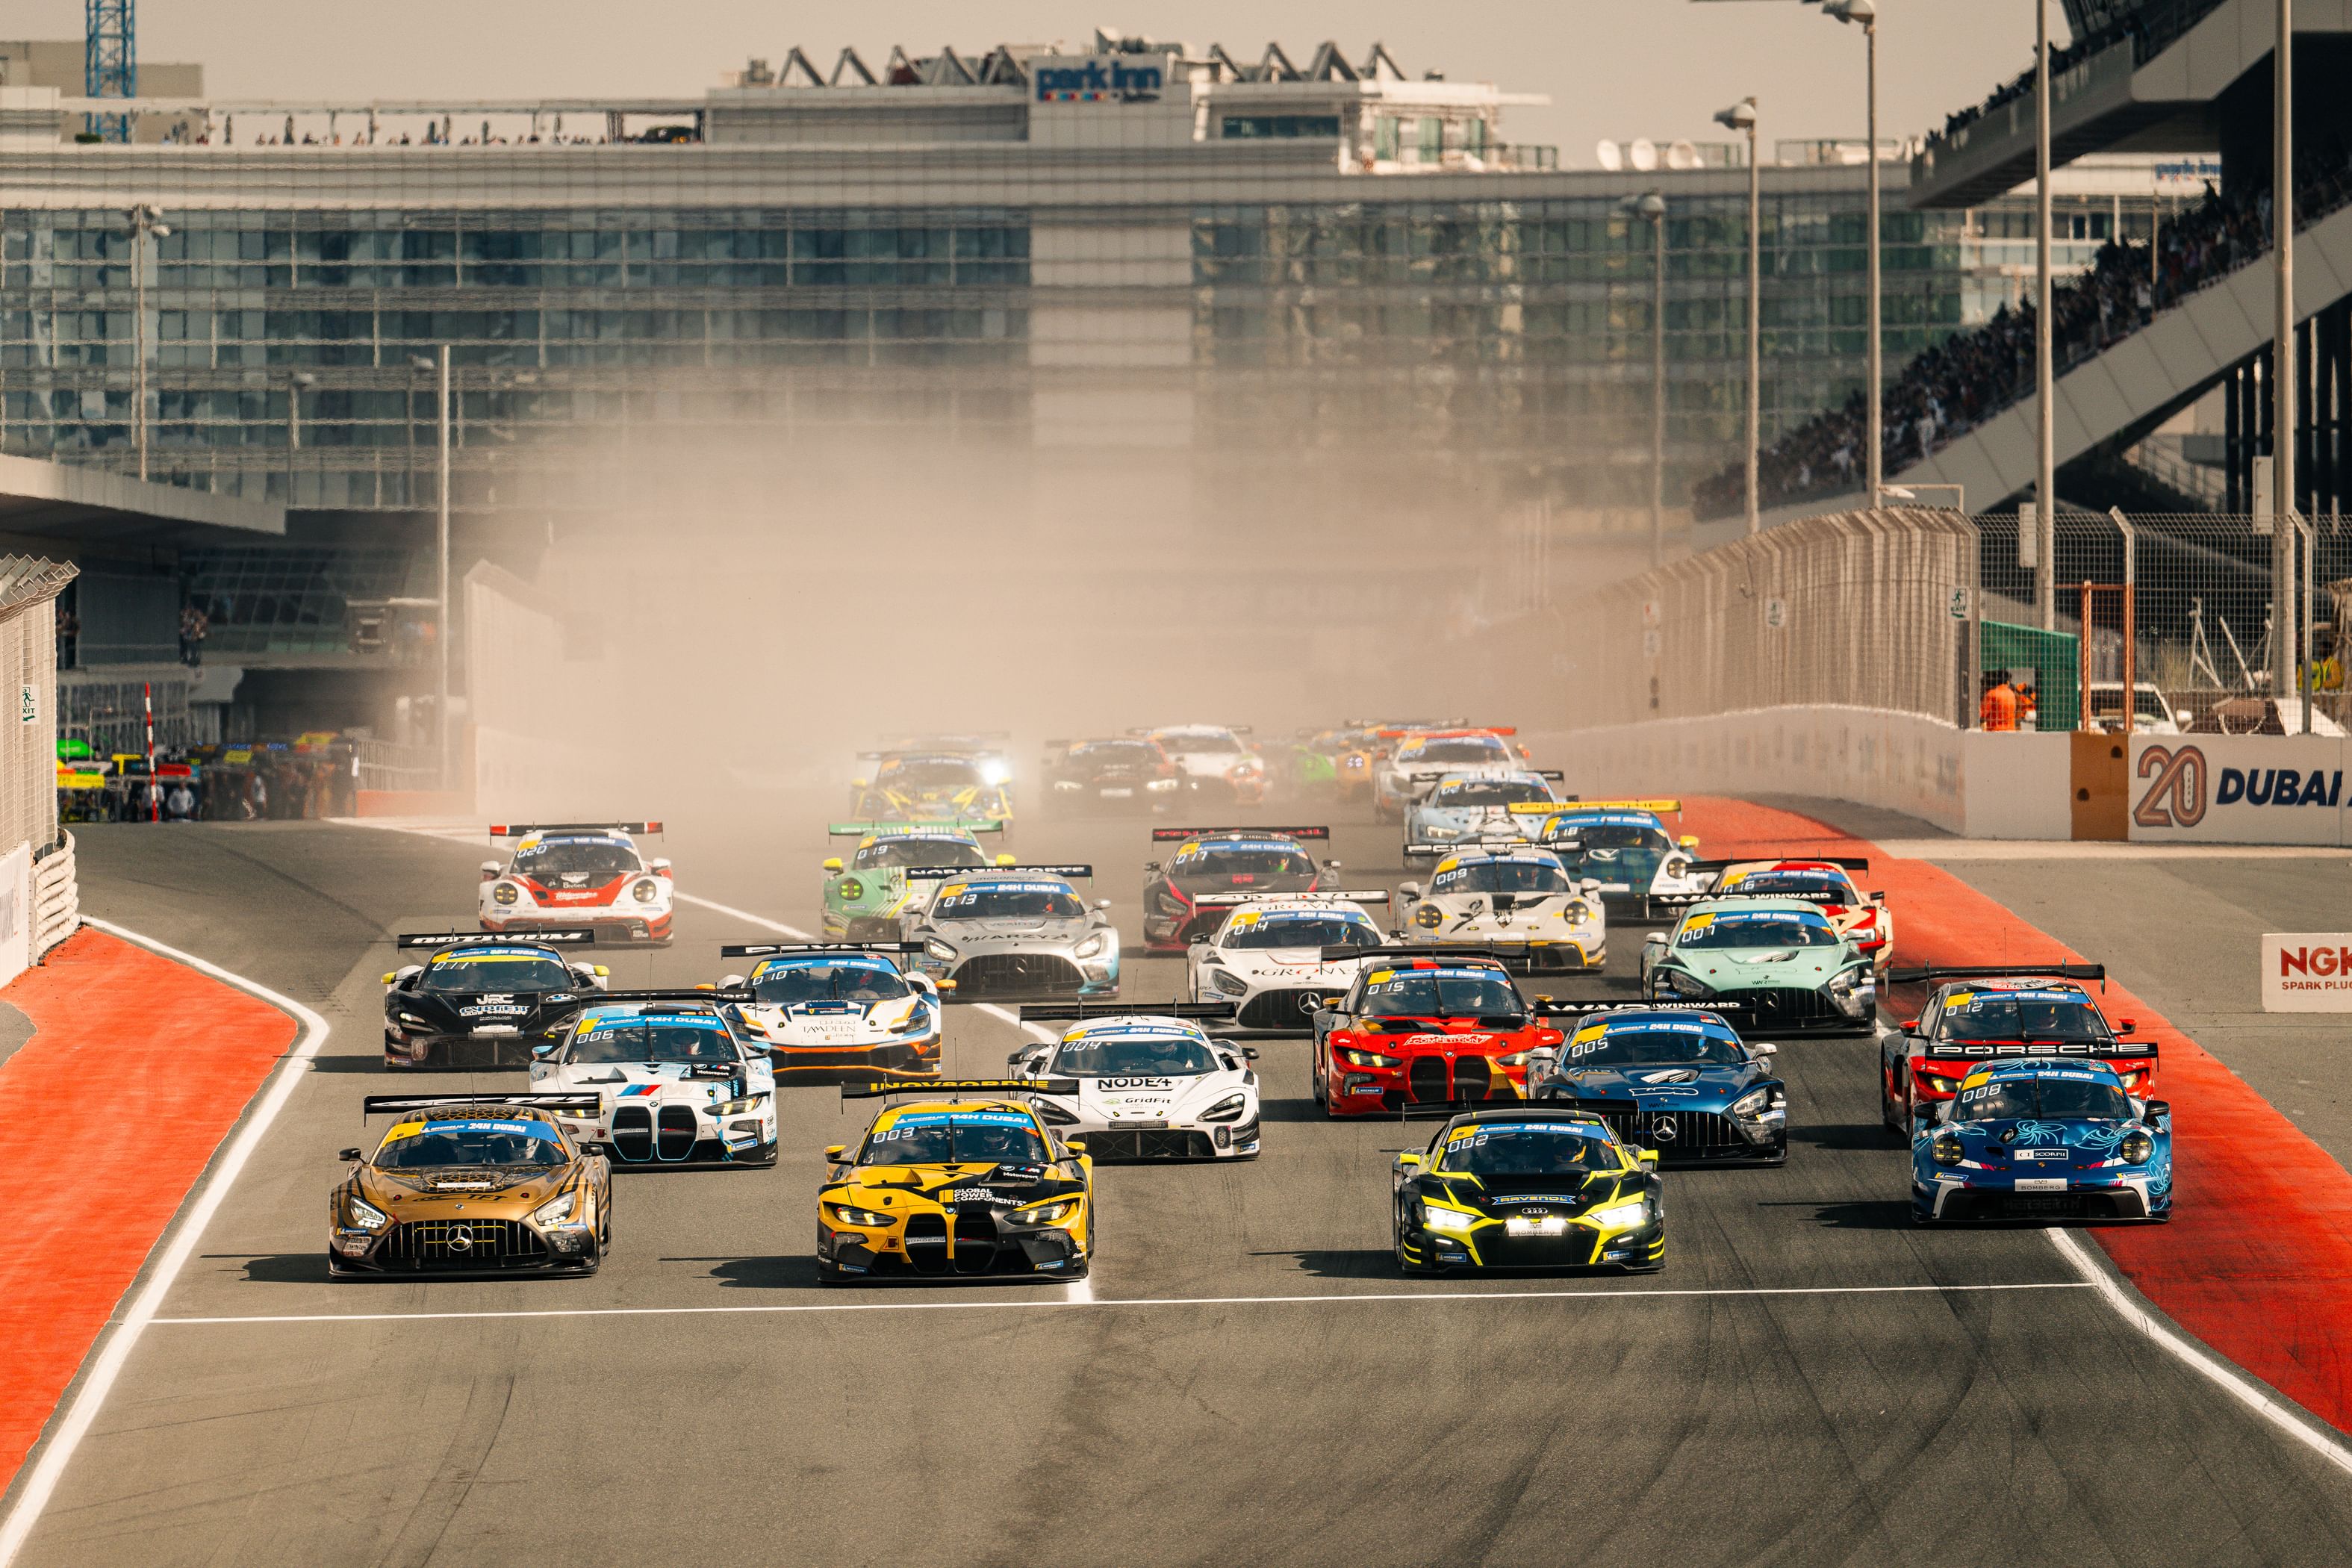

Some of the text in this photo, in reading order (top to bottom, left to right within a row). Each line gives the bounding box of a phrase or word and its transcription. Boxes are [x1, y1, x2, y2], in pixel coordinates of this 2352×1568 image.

[2133, 745, 2206, 827] 20
[2216, 768, 2342, 806] DUBAI
[1024, 884, 1060, 892] DUBAI
[1318, 912, 1345, 920] DUBAI
[2282, 981, 2321, 990] SPARK
[674, 1017, 717, 1026] DUBAI
[1672, 1024, 1703, 1033] DUBAI
[576, 1030, 614, 1044] 006
[1933, 1043, 2148, 1055] PORSCHE
[2061, 1071, 2094, 1080] DUBAI
[1962, 1083, 2002, 1104] 008
[982, 1115, 1027, 1123] DUBAI
[492, 1123, 526, 1133] DUBAI
[1549, 1124, 1584, 1133] DUBAI
[873, 1127, 915, 1143] 003
[1448, 1134, 1489, 1154] 002
